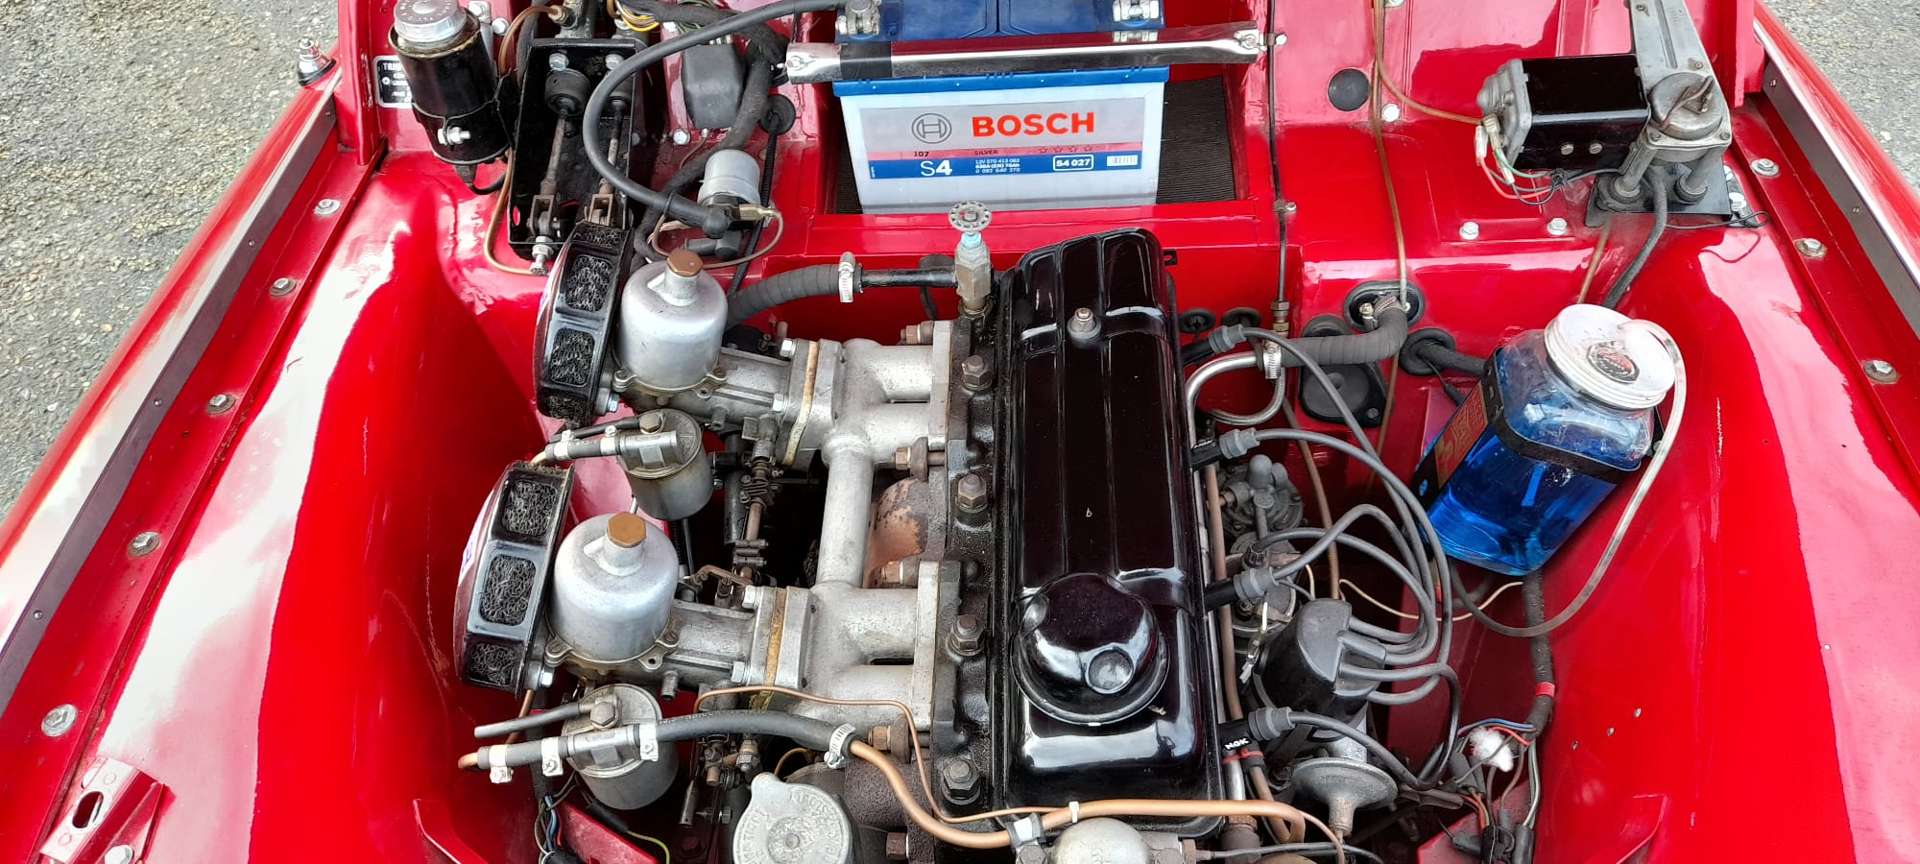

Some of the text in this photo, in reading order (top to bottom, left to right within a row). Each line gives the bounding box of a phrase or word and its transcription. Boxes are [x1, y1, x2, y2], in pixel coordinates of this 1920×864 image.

[972, 111, 1095, 138] BOSCH
[920, 159, 953, 177] S4
[1071, 158, 1091, 167] 027
[1224, 737, 1249, 750] NGK
